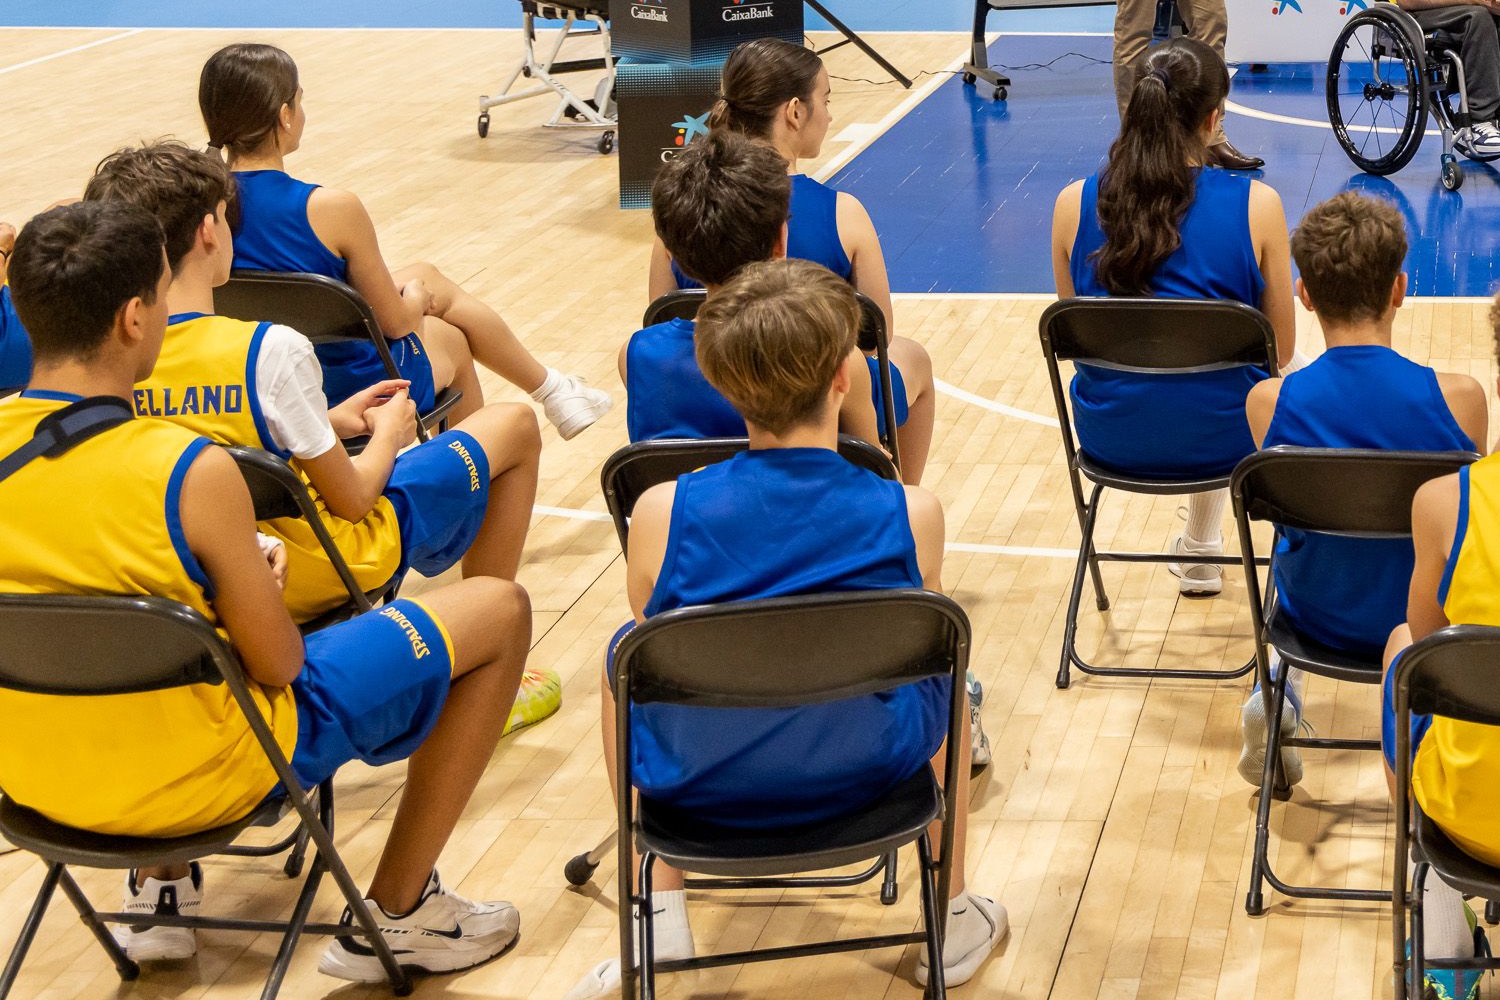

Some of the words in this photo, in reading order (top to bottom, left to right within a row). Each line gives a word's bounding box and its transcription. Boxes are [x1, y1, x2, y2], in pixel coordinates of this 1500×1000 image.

[630, 5, 669, 23] CaixaBank
[722, 6, 774, 22] CaixaBank
[133, 384, 243, 417] ELLANO
[448, 440, 481, 492] SPALDING
[379, 606, 431, 660] SPALDING
